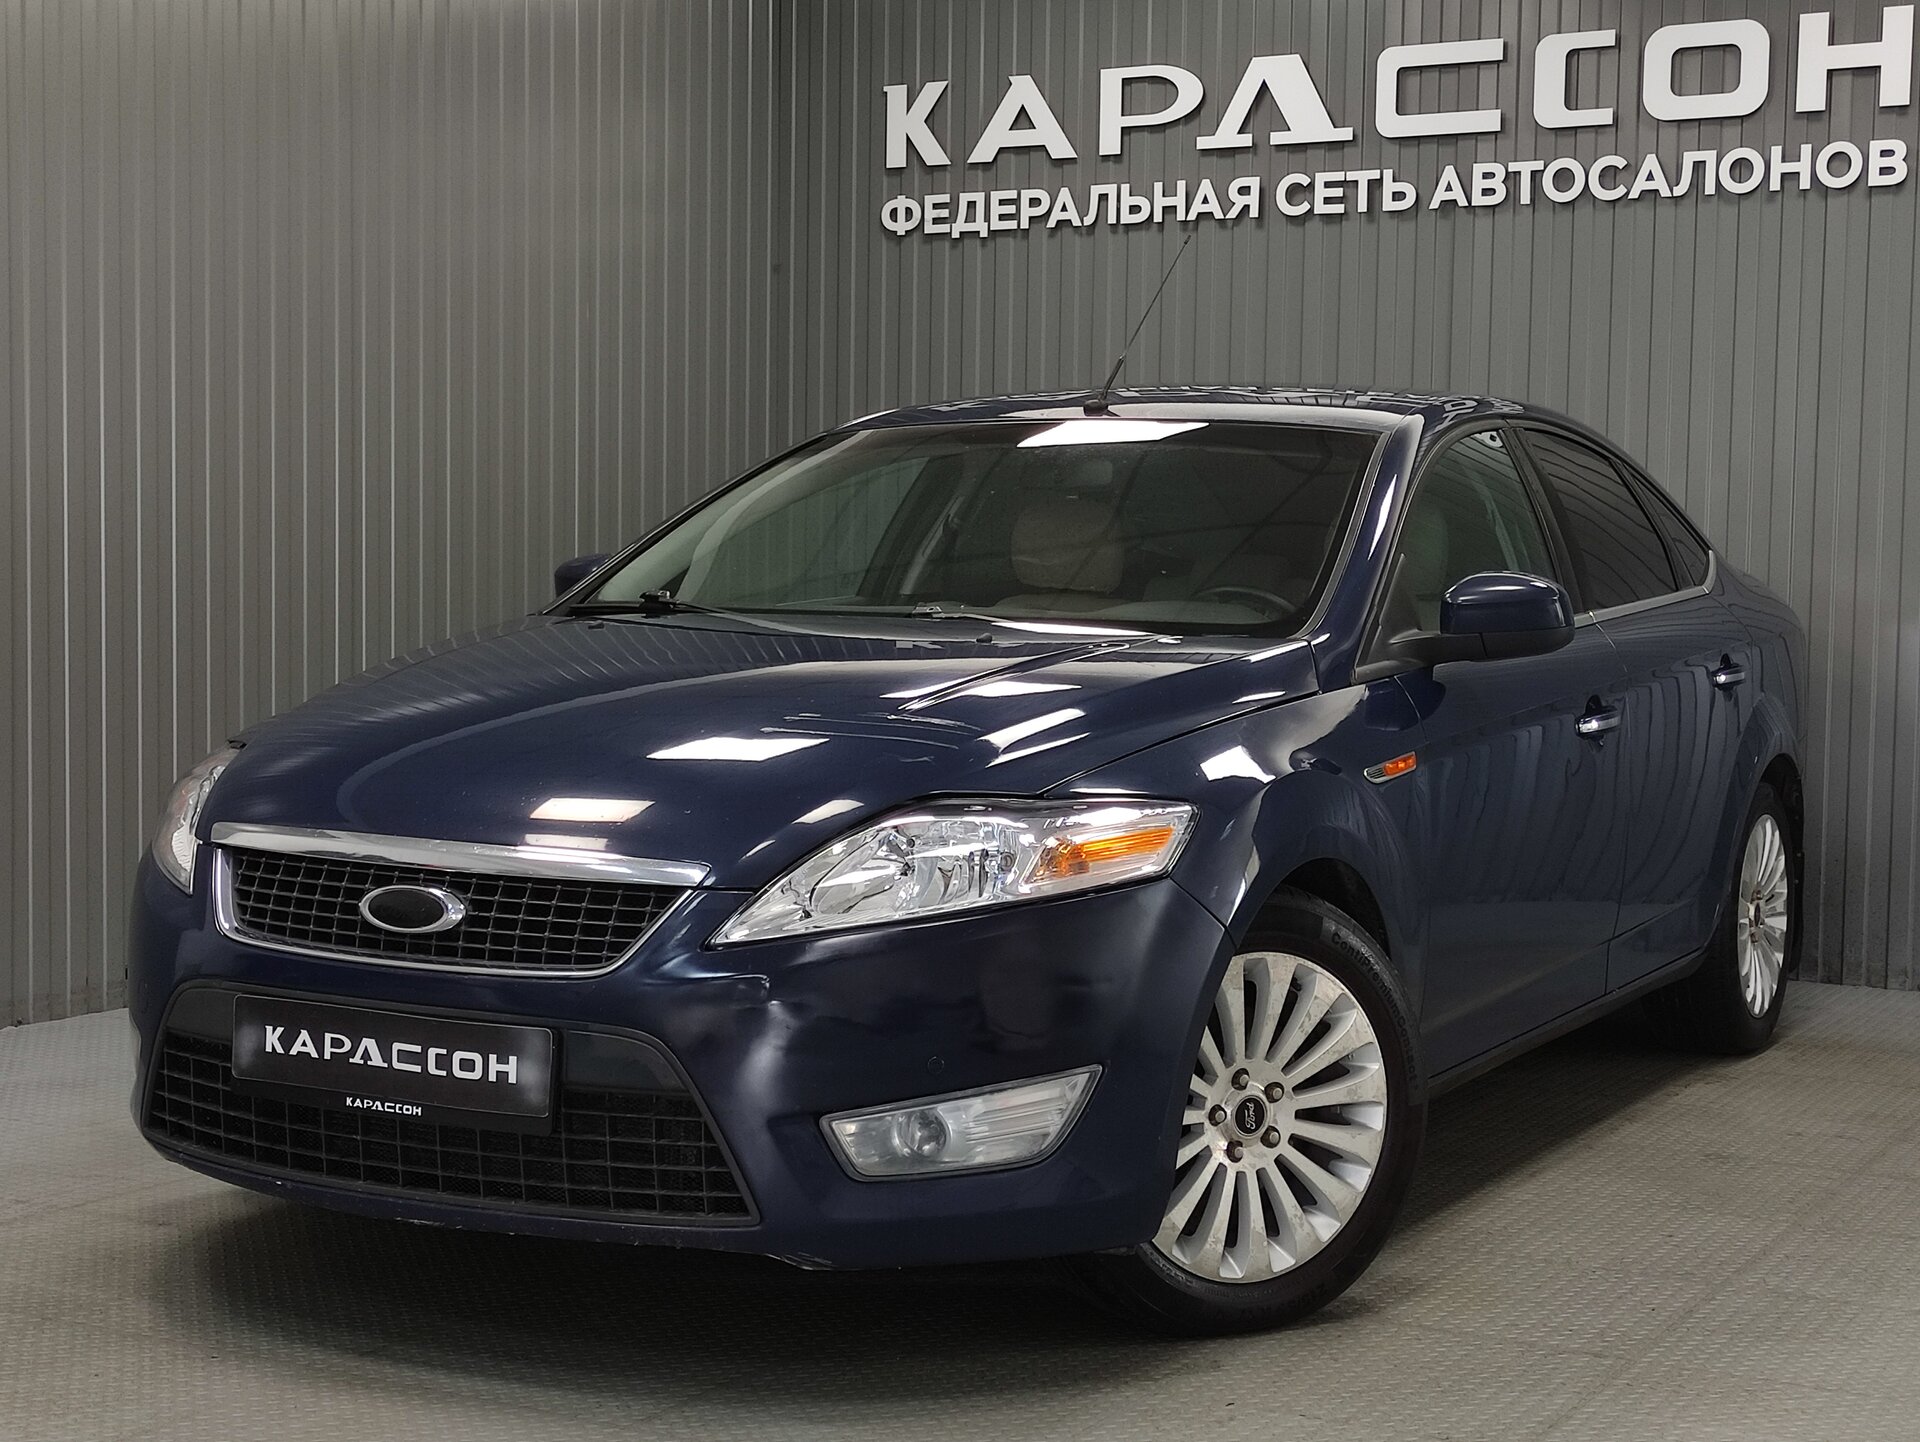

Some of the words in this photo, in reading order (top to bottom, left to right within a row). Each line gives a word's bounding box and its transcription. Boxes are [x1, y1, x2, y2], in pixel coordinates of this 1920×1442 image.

[883, 5, 1914, 168] КАРАССОН
[880, 176, 1260, 239] ФЕДЕРАЛЬНАЯ
[1275, 168, 1418, 217] СЕТЬ
[1428, 138, 1909, 210] АВТОСАЛОНОВ
[264, 1025, 518, 1084] КАРАССОН
[345, 1096, 422, 1116] КАРАССОН
[1245, 1102, 1256, 1130] Ford
